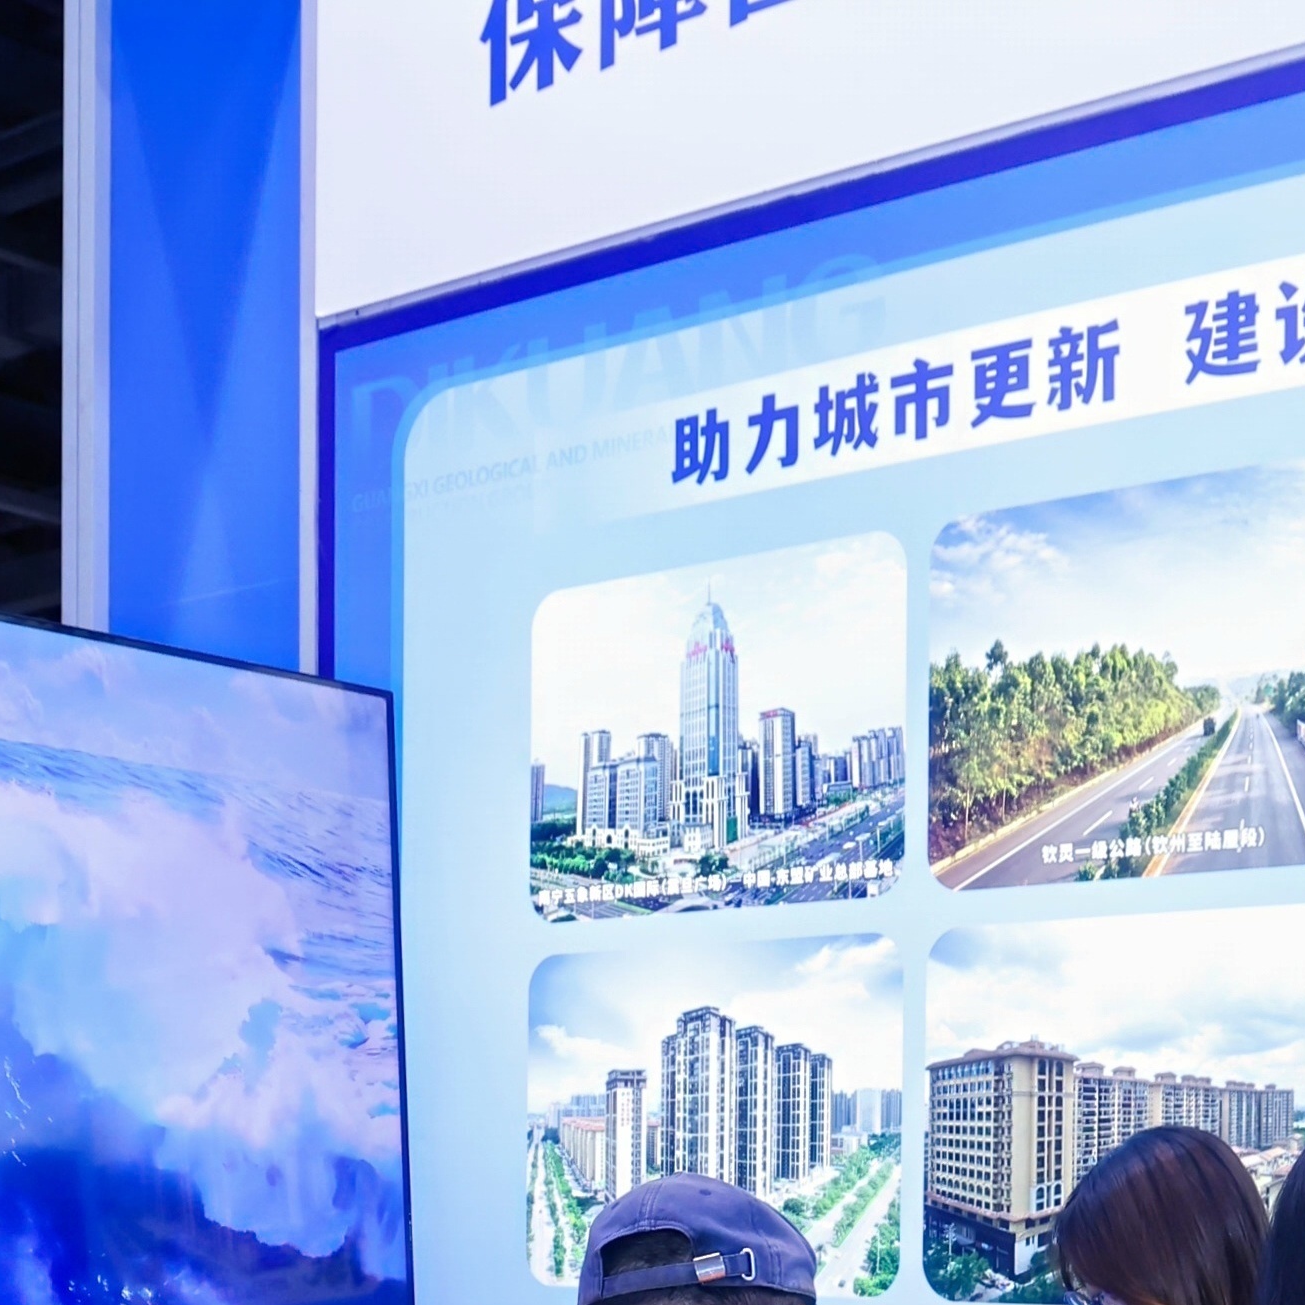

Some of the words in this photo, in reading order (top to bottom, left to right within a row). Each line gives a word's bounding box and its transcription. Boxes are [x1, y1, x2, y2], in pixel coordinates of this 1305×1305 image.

[671, 317, 1121, 486] 助力城市更新
[432, 454, 542, 497] GEOLOGICAL
[545, 442, 588, 472] AND
